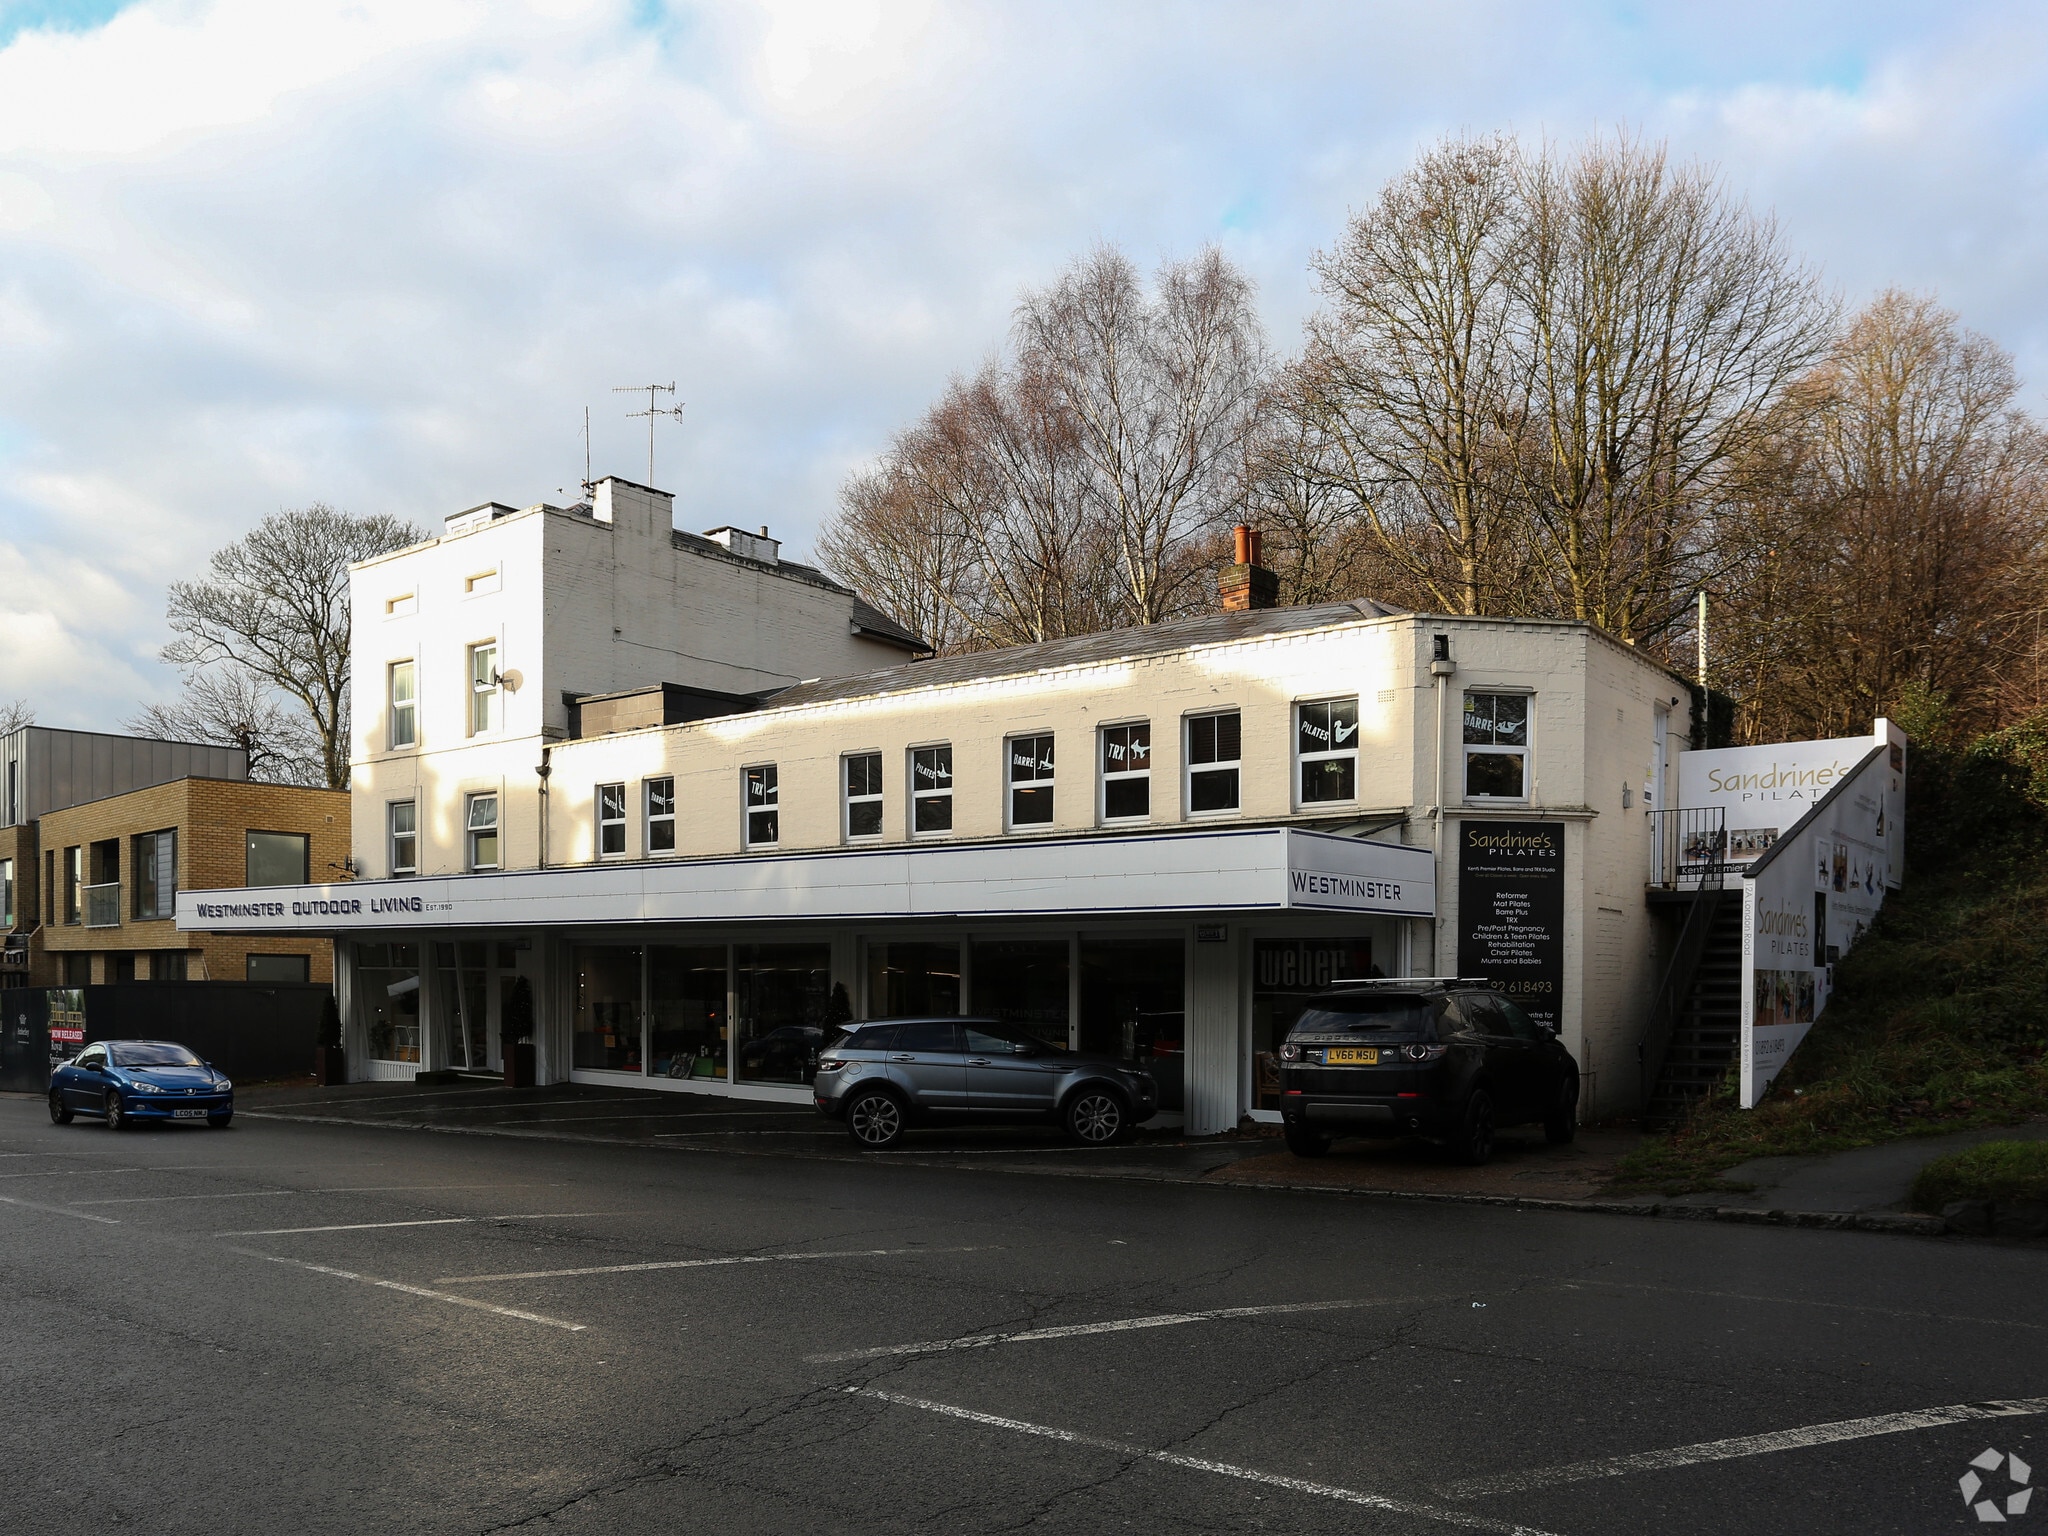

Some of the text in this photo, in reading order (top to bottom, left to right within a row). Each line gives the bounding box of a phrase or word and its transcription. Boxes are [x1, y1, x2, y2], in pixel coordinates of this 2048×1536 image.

[1300, 720, 1329, 741] PILATES
[1464, 712, 1493, 732] BARRE
[1107, 743, 1127, 760] TRX
[1013, 753, 1035, 768] BARRE
[915, 762, 936, 780] PILATES
[751, 781, 764, 796] TRX
[1742, 788, 1822, 802] PILAT
[1468, 830, 1552, 848] Sandrine's
[1489, 848, 1557, 857] PILATES
[1292, 871, 1401, 900] WESTMINSTER
[197, 903, 284, 918] WESTMINSTER
[292, 900, 362, 915] OUTDOOR
[371, 897, 423, 913] LIVING
[1744, 900, 1753, 932] London
[1758, 897, 1809, 938] Sandrine's
[1508, 925, 1545, 933] Pregnancy
[1743, 933, 1752, 956] Road
[1771, 940, 1809, 956] PILATES
[1259, 940, 1345, 987] weber
[1519, 957, 1542, 965] Babies
[1509, 981, 1553, 993] 618493
[61, 1029, 83, 1041] RELEASED
[1329, 1050, 1353, 1060] LV66
